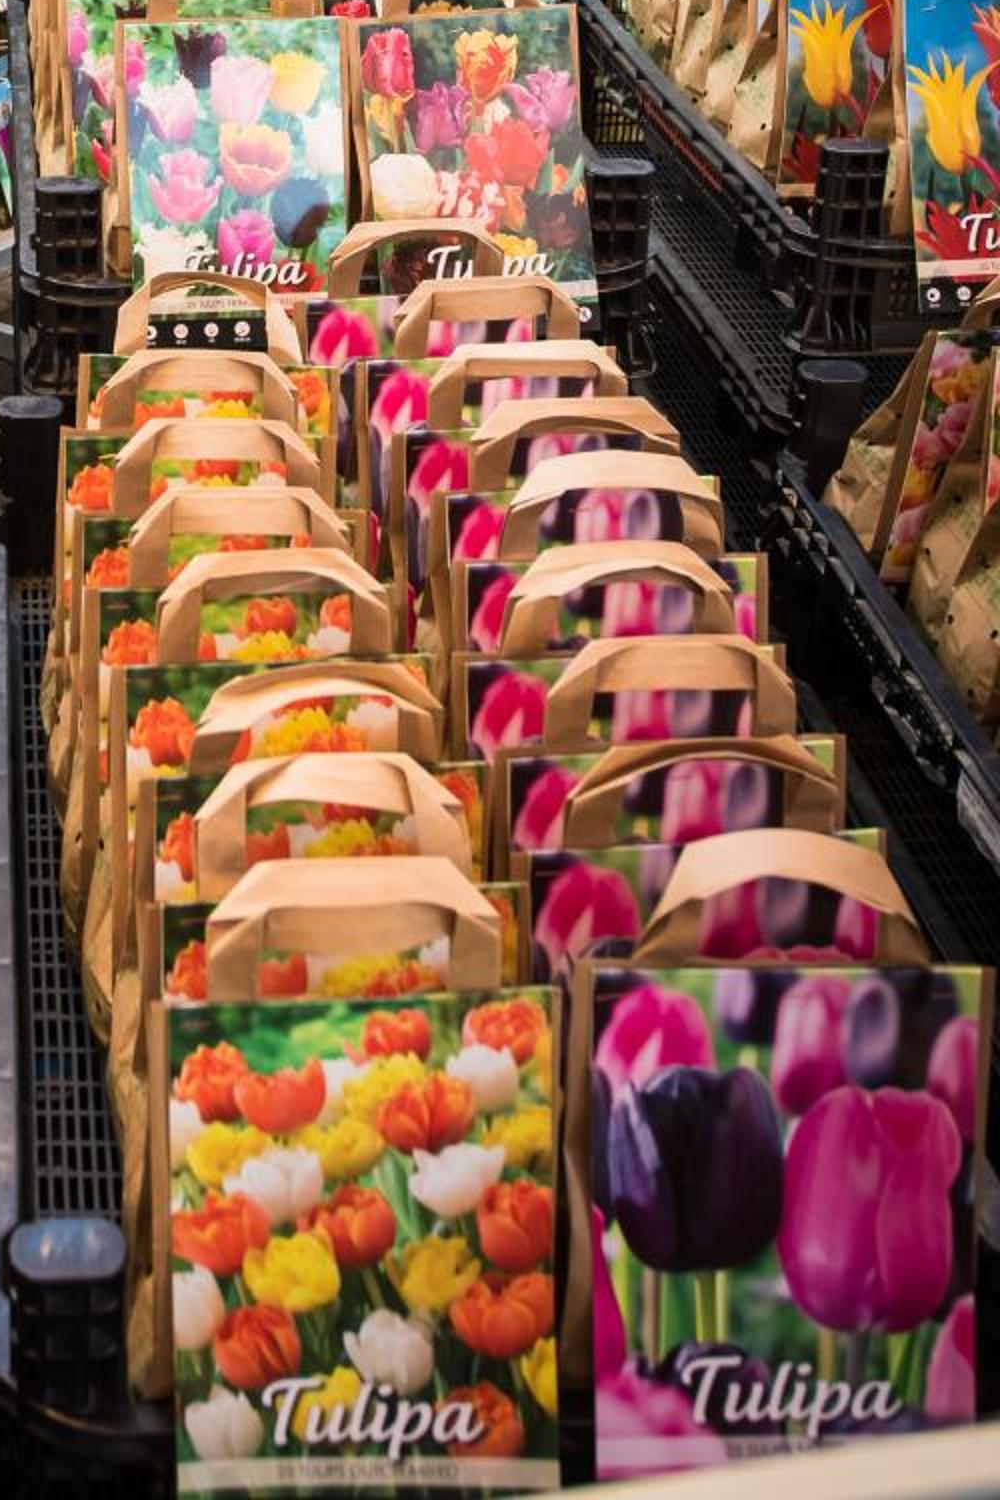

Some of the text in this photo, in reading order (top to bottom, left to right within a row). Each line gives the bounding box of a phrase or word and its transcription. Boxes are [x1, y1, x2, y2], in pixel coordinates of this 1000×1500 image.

[427, 245, 555, 281] Tupa
[261, 1375, 486, 1461] Tulipa
[681, 1353, 902, 1439] Tulipa
